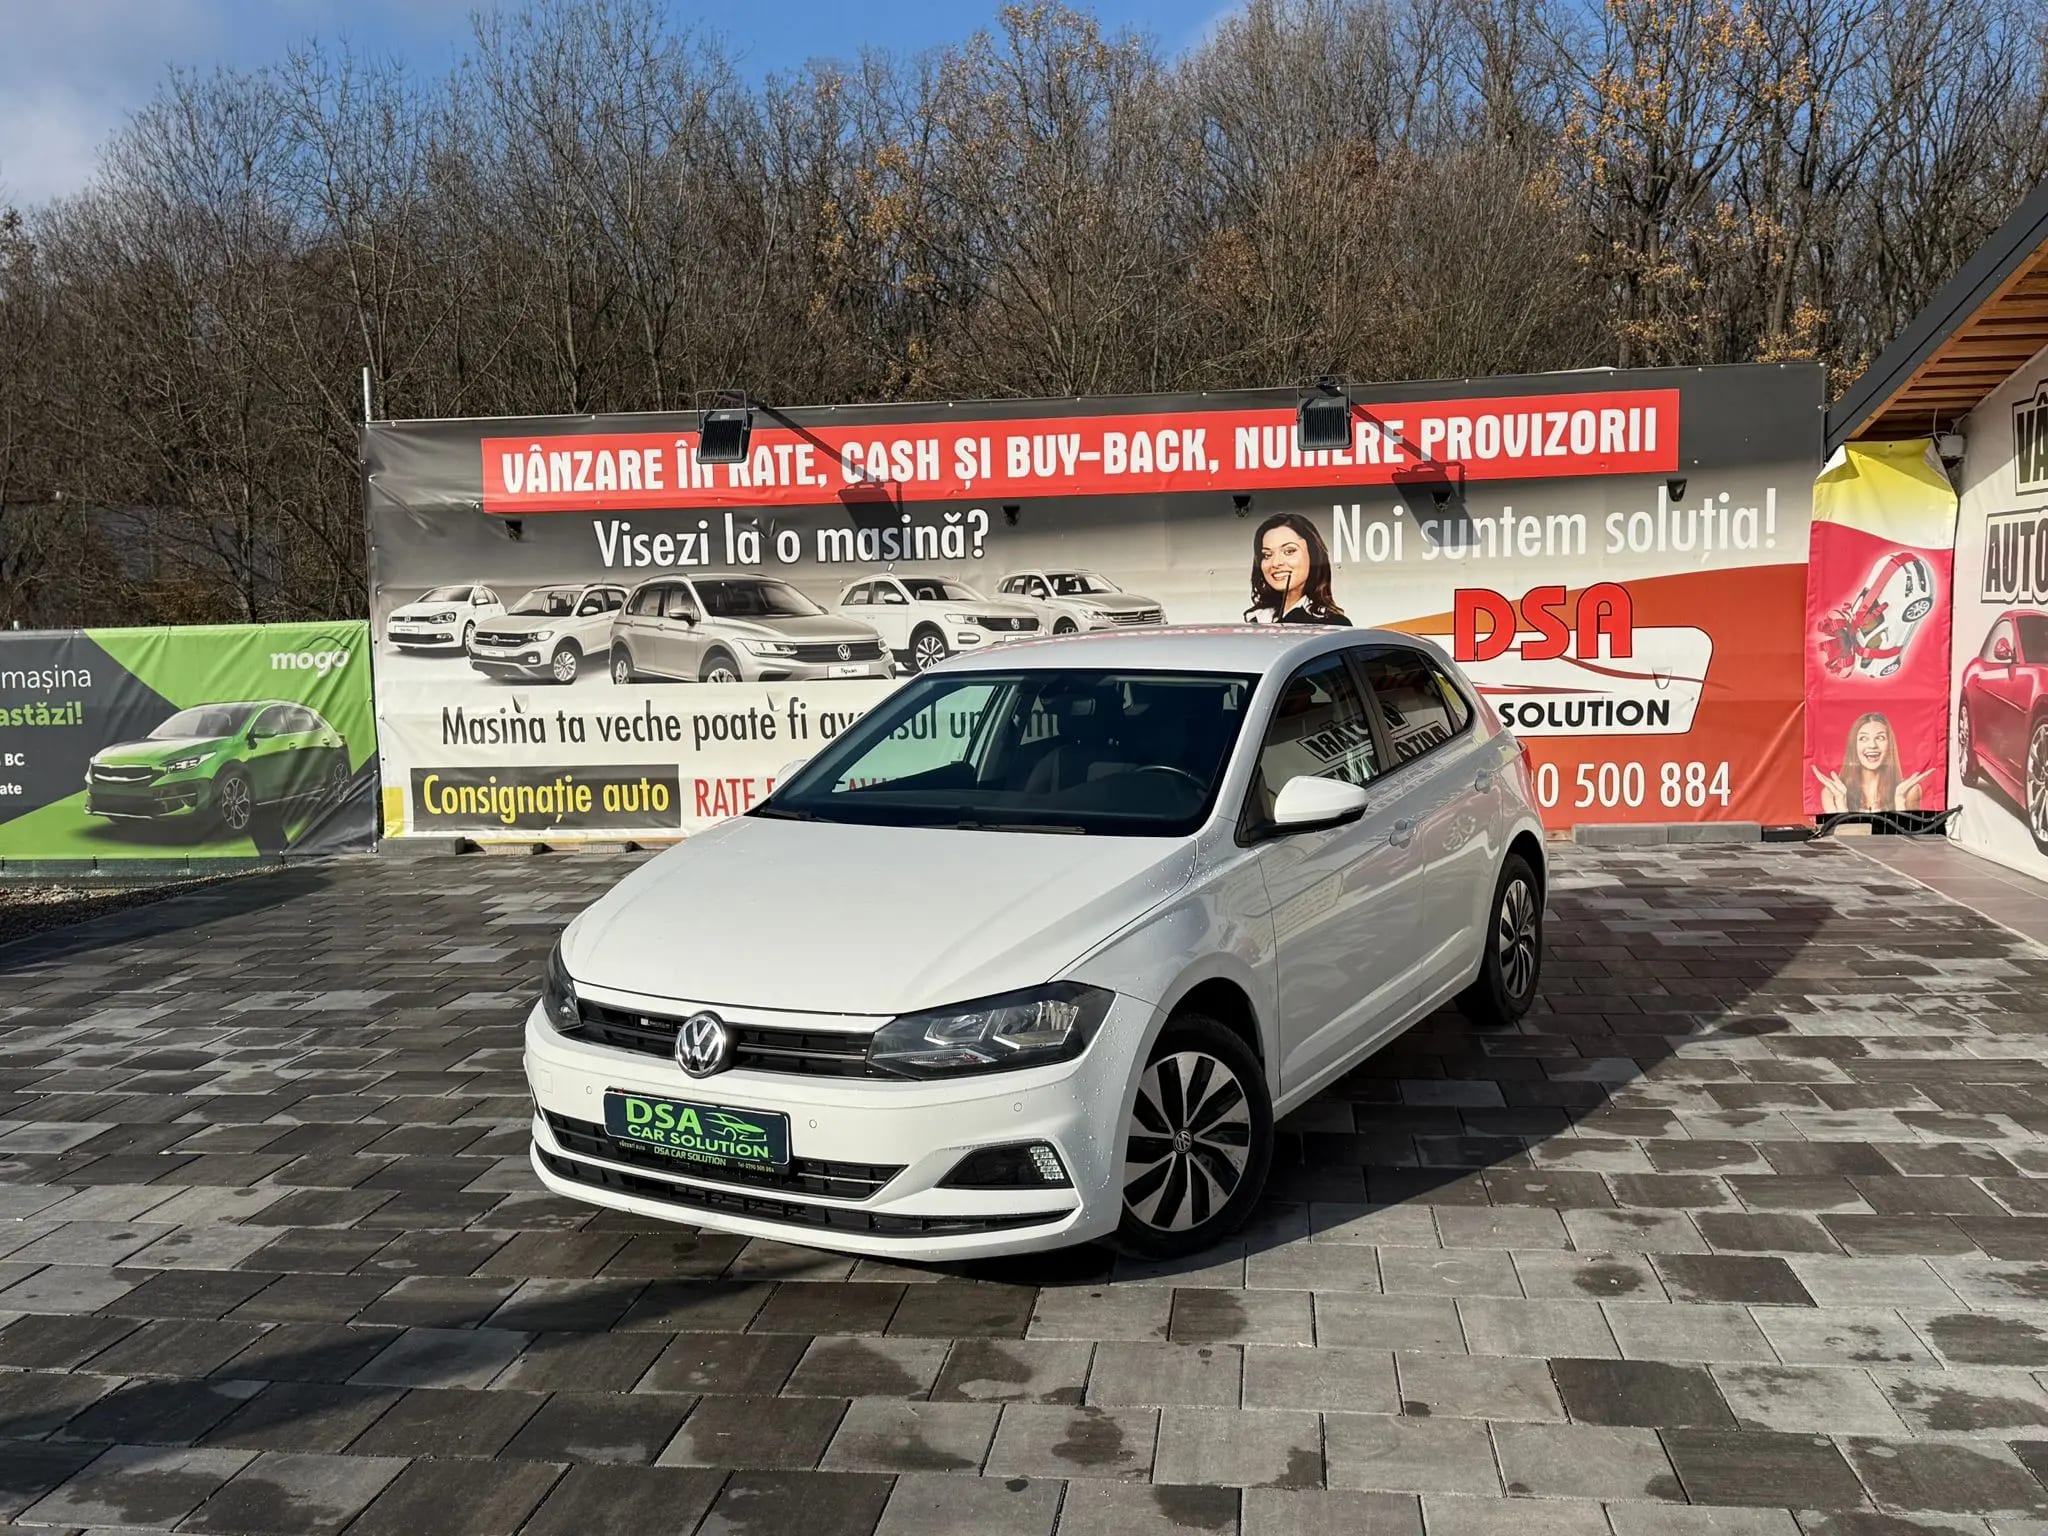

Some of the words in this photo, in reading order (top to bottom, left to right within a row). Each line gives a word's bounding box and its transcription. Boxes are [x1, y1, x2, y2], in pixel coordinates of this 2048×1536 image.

[501, 443, 664, 494] VÂNZARE
[729, 443, 827, 488] RATE,
[841, 438, 939, 484] CASH
[954, 436, 991, 490] ȘI
[1006, 429, 1219, 478] BUY-BACK,
[1420, 406, 1657, 462] PROVIZORII
[593, 519, 710, 569] Visezi
[724, 512, 762, 565] la
[777, 530, 800, 564] o
[816, 508, 990, 571] mașină?
[1332, 504, 1404, 563] Noi
[1420, 506, 1586, 561] suntem
[1605, 485, 1777, 563] soluția!
[1453, 581, 1633, 663] DSA
[1, 664, 92, 694] mașina
[270, 646, 351, 678] mogo
[556, 710, 586, 744] ta
[595, 700, 681, 743] veche
[693, 706, 776, 751] poate
[787, 697, 808, 740] fi
[1499, 699, 1670, 728] SOLUTION
[423, 774, 593, 824] Consignație
[602, 777, 670, 813] auto
[1574, 761, 1646, 808] 500
[1660, 761, 1732, 808] 884
[625, 1097, 703, 1135] DSA
[627, 1124, 665, 1142] CAR
[670, 1132, 769, 1159] SOLUTION
[653, 1146, 670, 1157] DSA
[671, 1149, 686, 1160] CAR
[687, 1152, 726, 1167] SOLUTION
